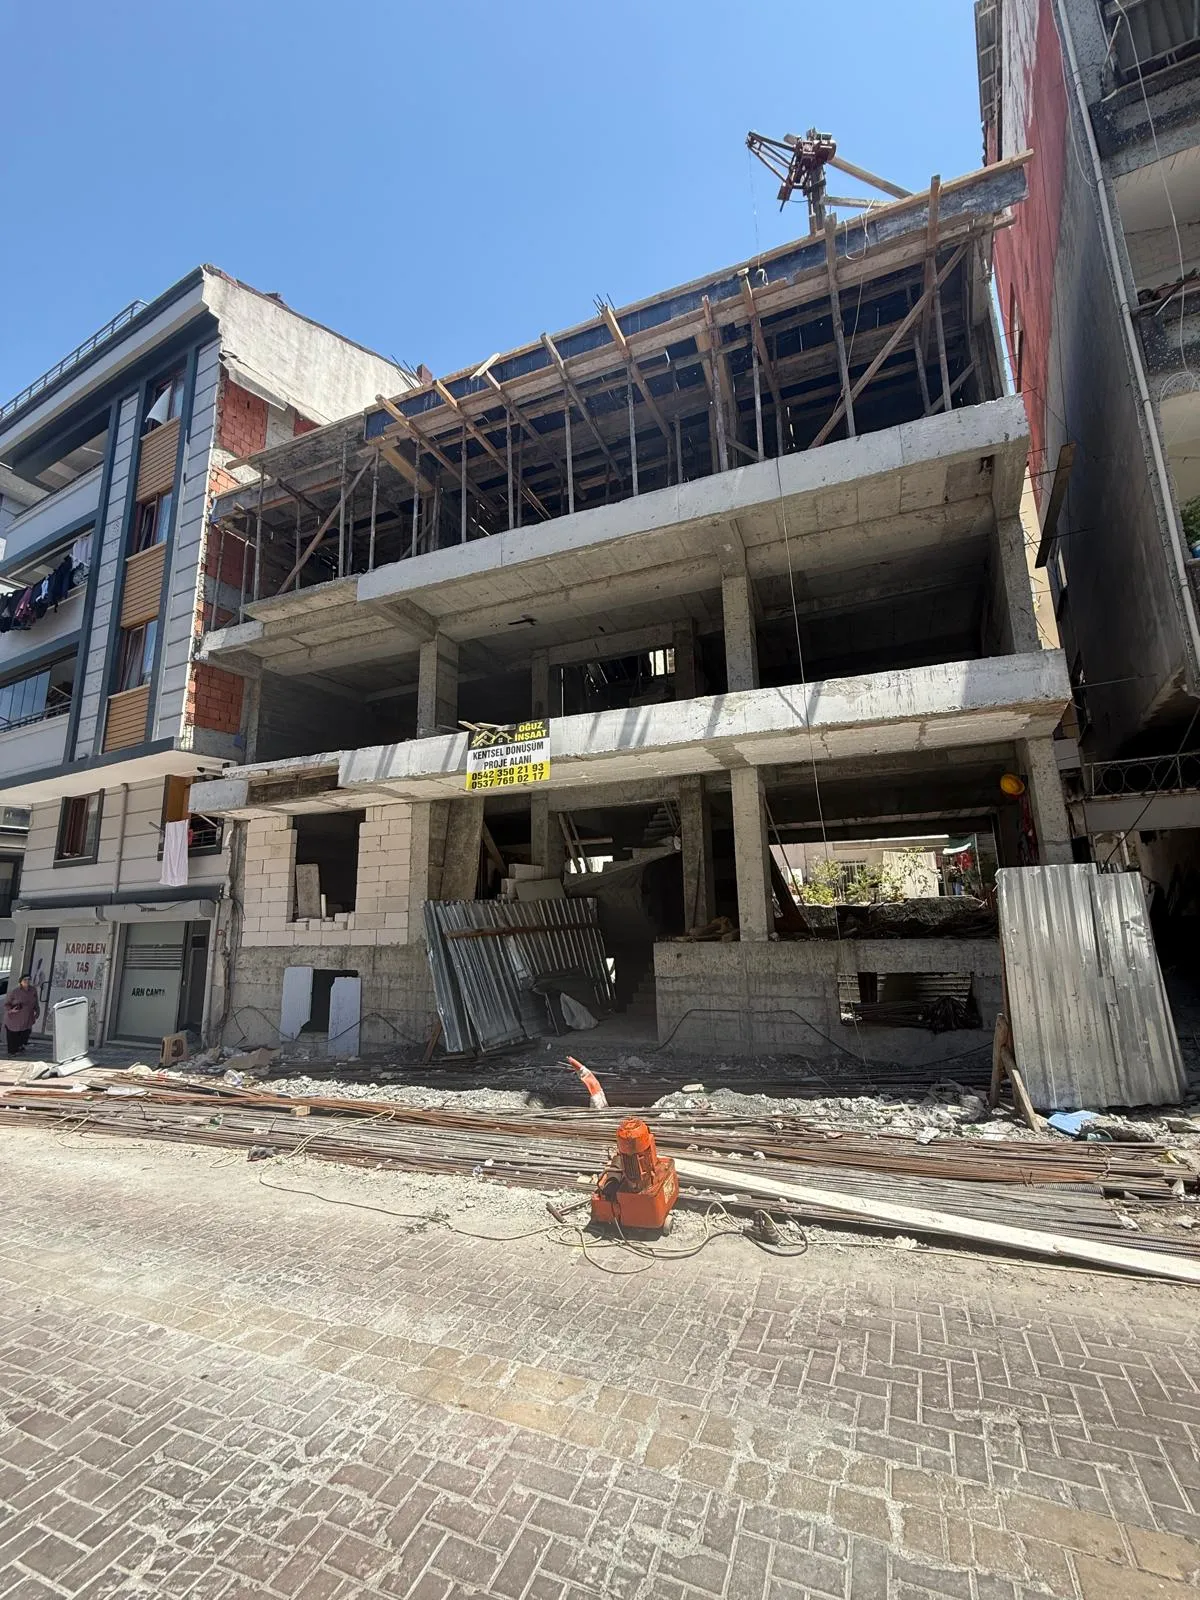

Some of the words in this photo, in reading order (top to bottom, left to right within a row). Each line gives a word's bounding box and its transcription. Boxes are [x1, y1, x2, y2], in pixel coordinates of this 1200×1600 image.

[473, 747, 503, 760] KENTSEL
[483, 759, 507, 770] PROJE
[510, 755, 532, 767] ALANI
[472, 770, 494, 781] 0542
[497, 768, 514, 777] 350
[517, 766, 528, 774] 21
[532, 763, 544, 772] 93
[472, 779, 494, 789] 0537
[497, 776, 514, 785] 769
[517, 774, 528, 783] 02
[532, 772, 544, 780] 17
[65, 942, 106, 954] KARDELEN
